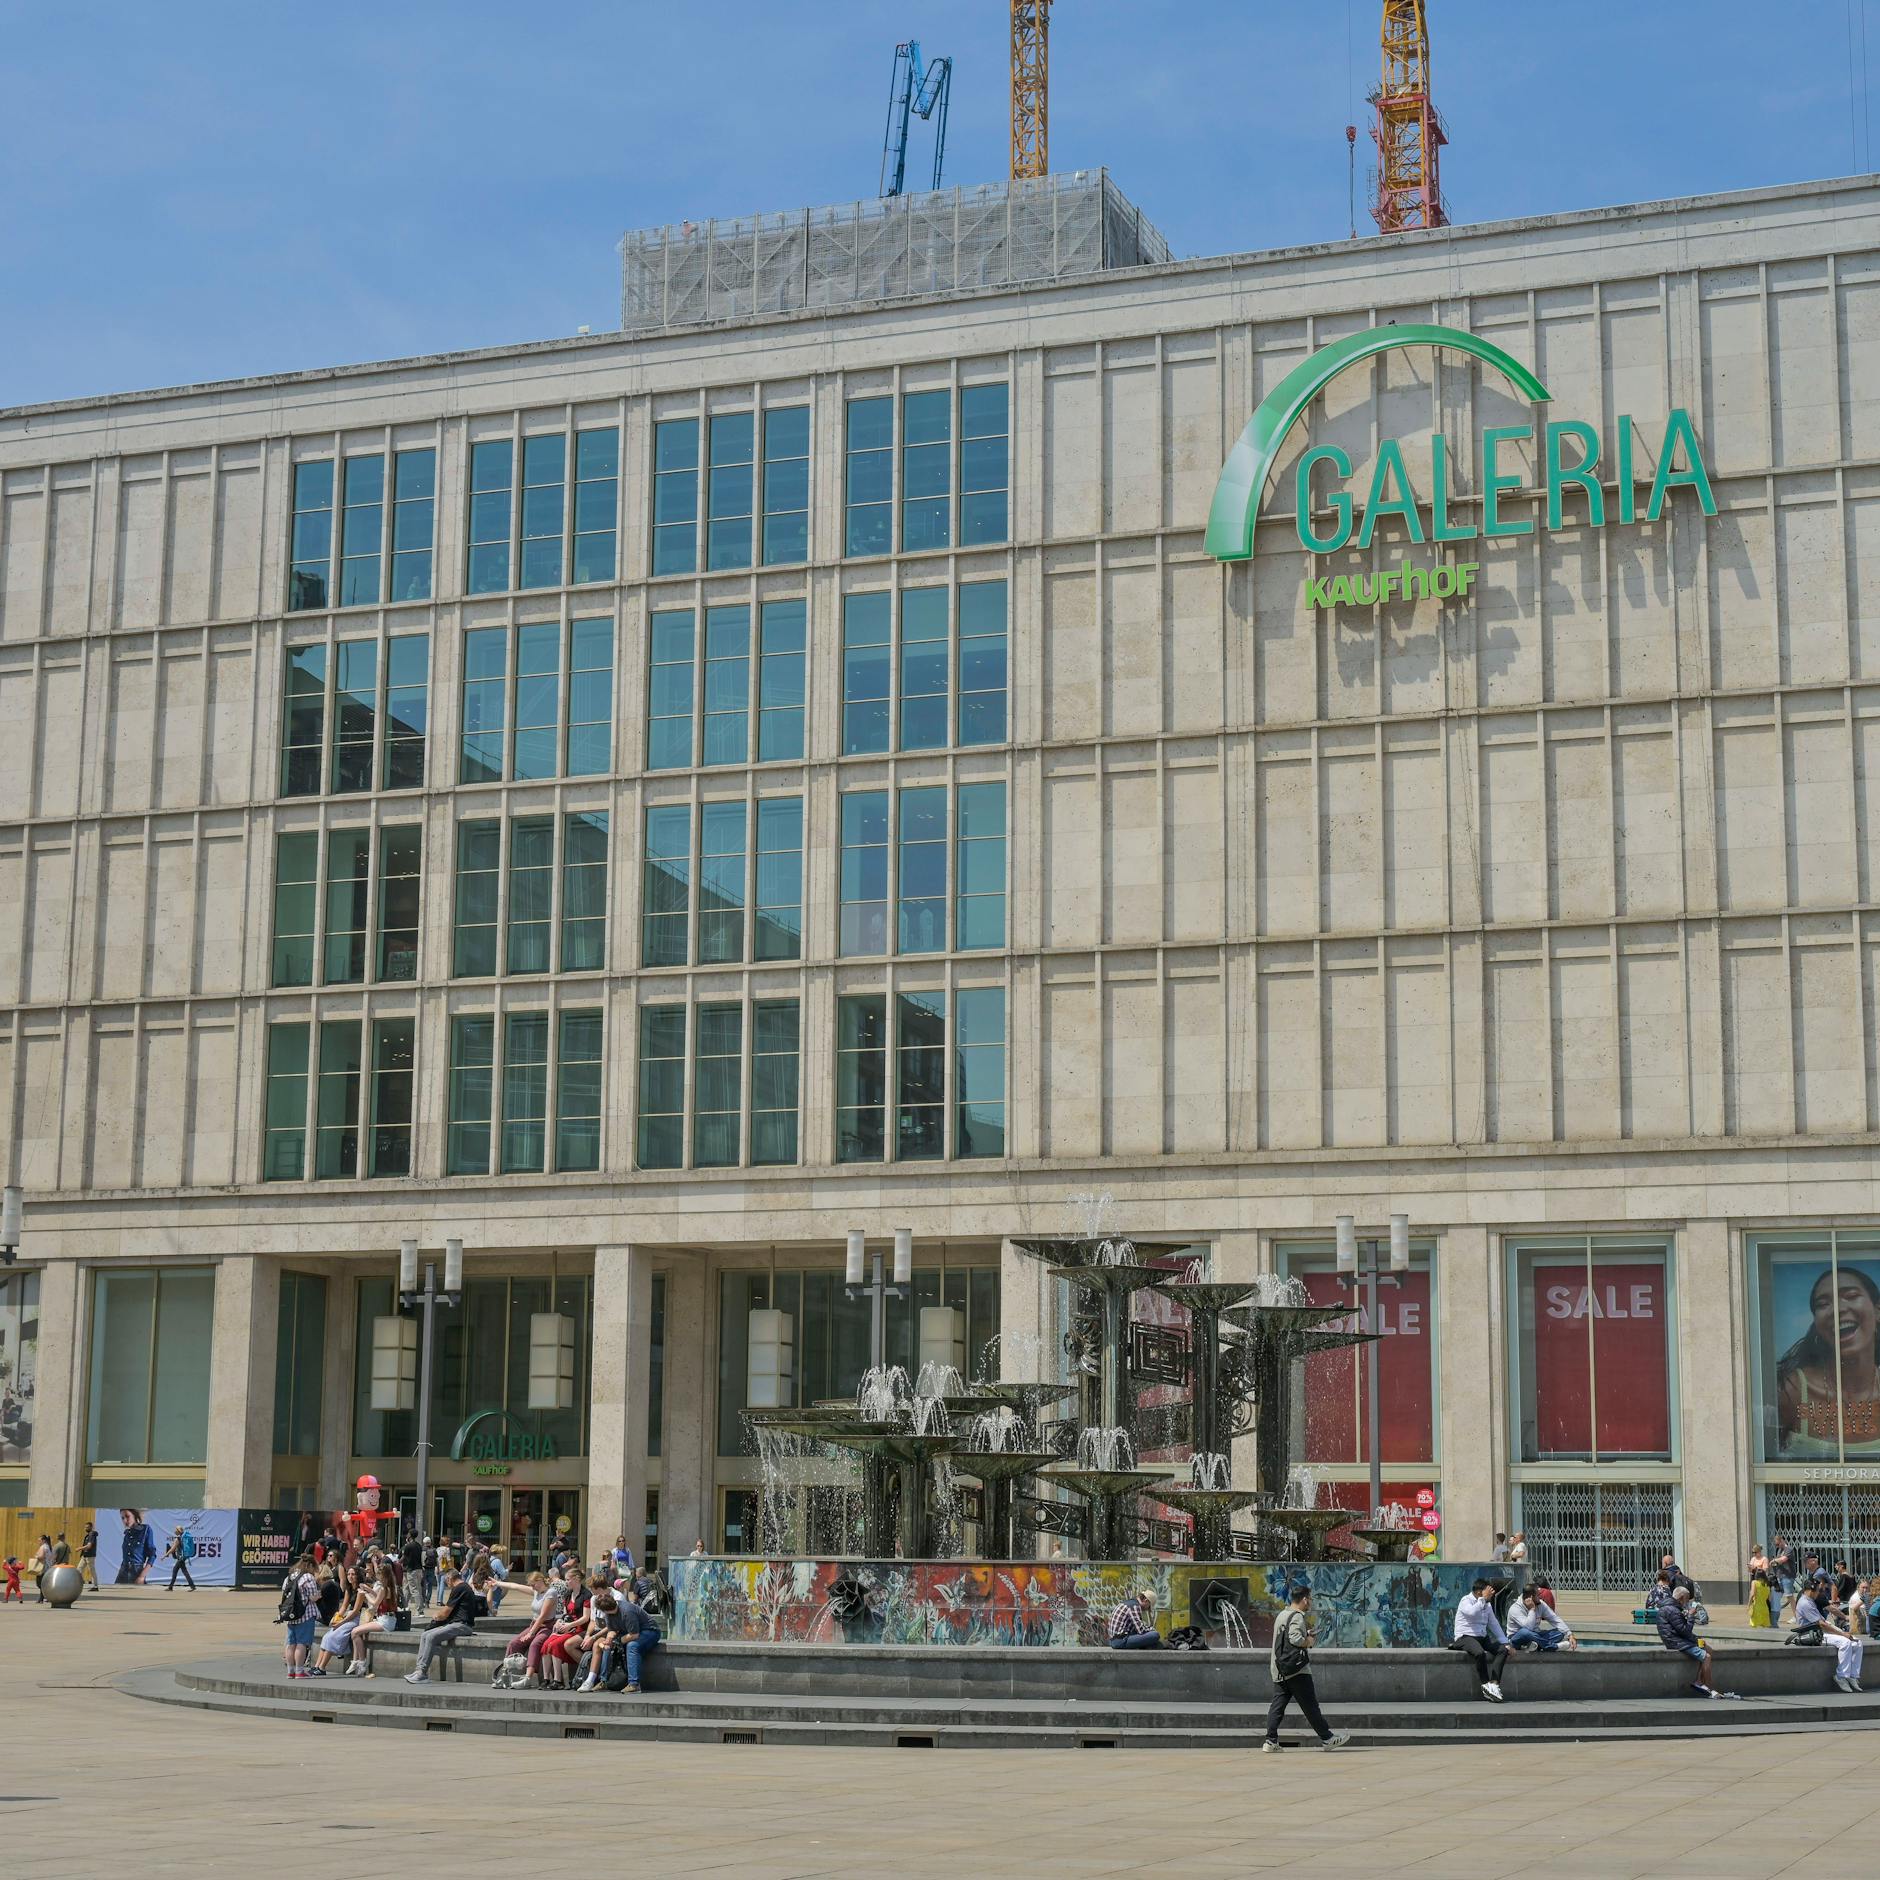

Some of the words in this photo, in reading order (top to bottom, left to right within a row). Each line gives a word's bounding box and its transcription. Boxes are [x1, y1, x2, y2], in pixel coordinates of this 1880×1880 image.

[1296, 409, 1718, 554] GALERIA
[1546, 1285, 1653, 1318] SALE
[470, 1433, 556, 1461] GALERIA
[1803, 1467, 1880, 1479] SEPHORA
[243, 1534, 261, 1547] WIR
[262, 1534, 290, 1547] HABEN
[242, 1547, 289, 1564] GEÖFFNET!
